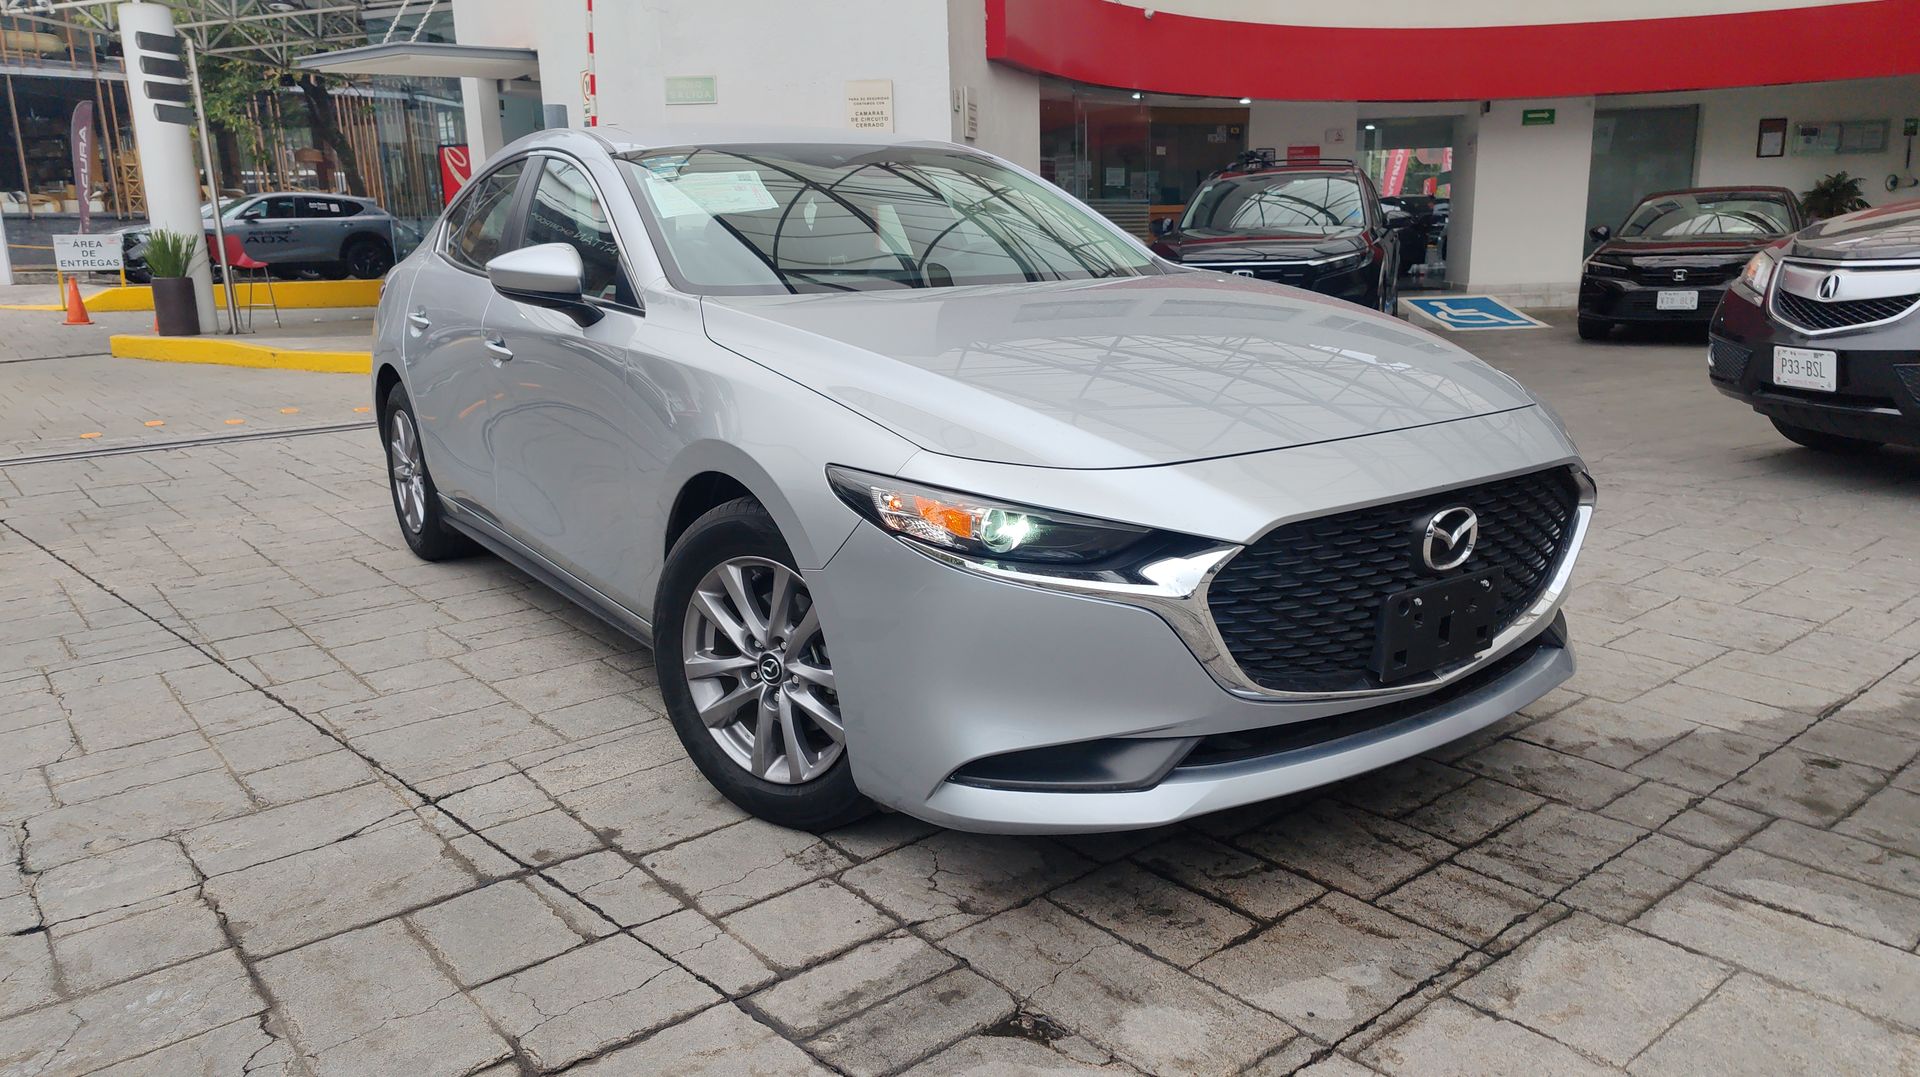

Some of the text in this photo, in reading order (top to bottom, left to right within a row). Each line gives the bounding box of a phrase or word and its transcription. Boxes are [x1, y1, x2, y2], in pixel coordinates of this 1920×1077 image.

[79, 126, 89, 204] ACURA
[73, 239, 103, 248] ÁREA
[1782, 358, 1826, 378] P33-BSL
